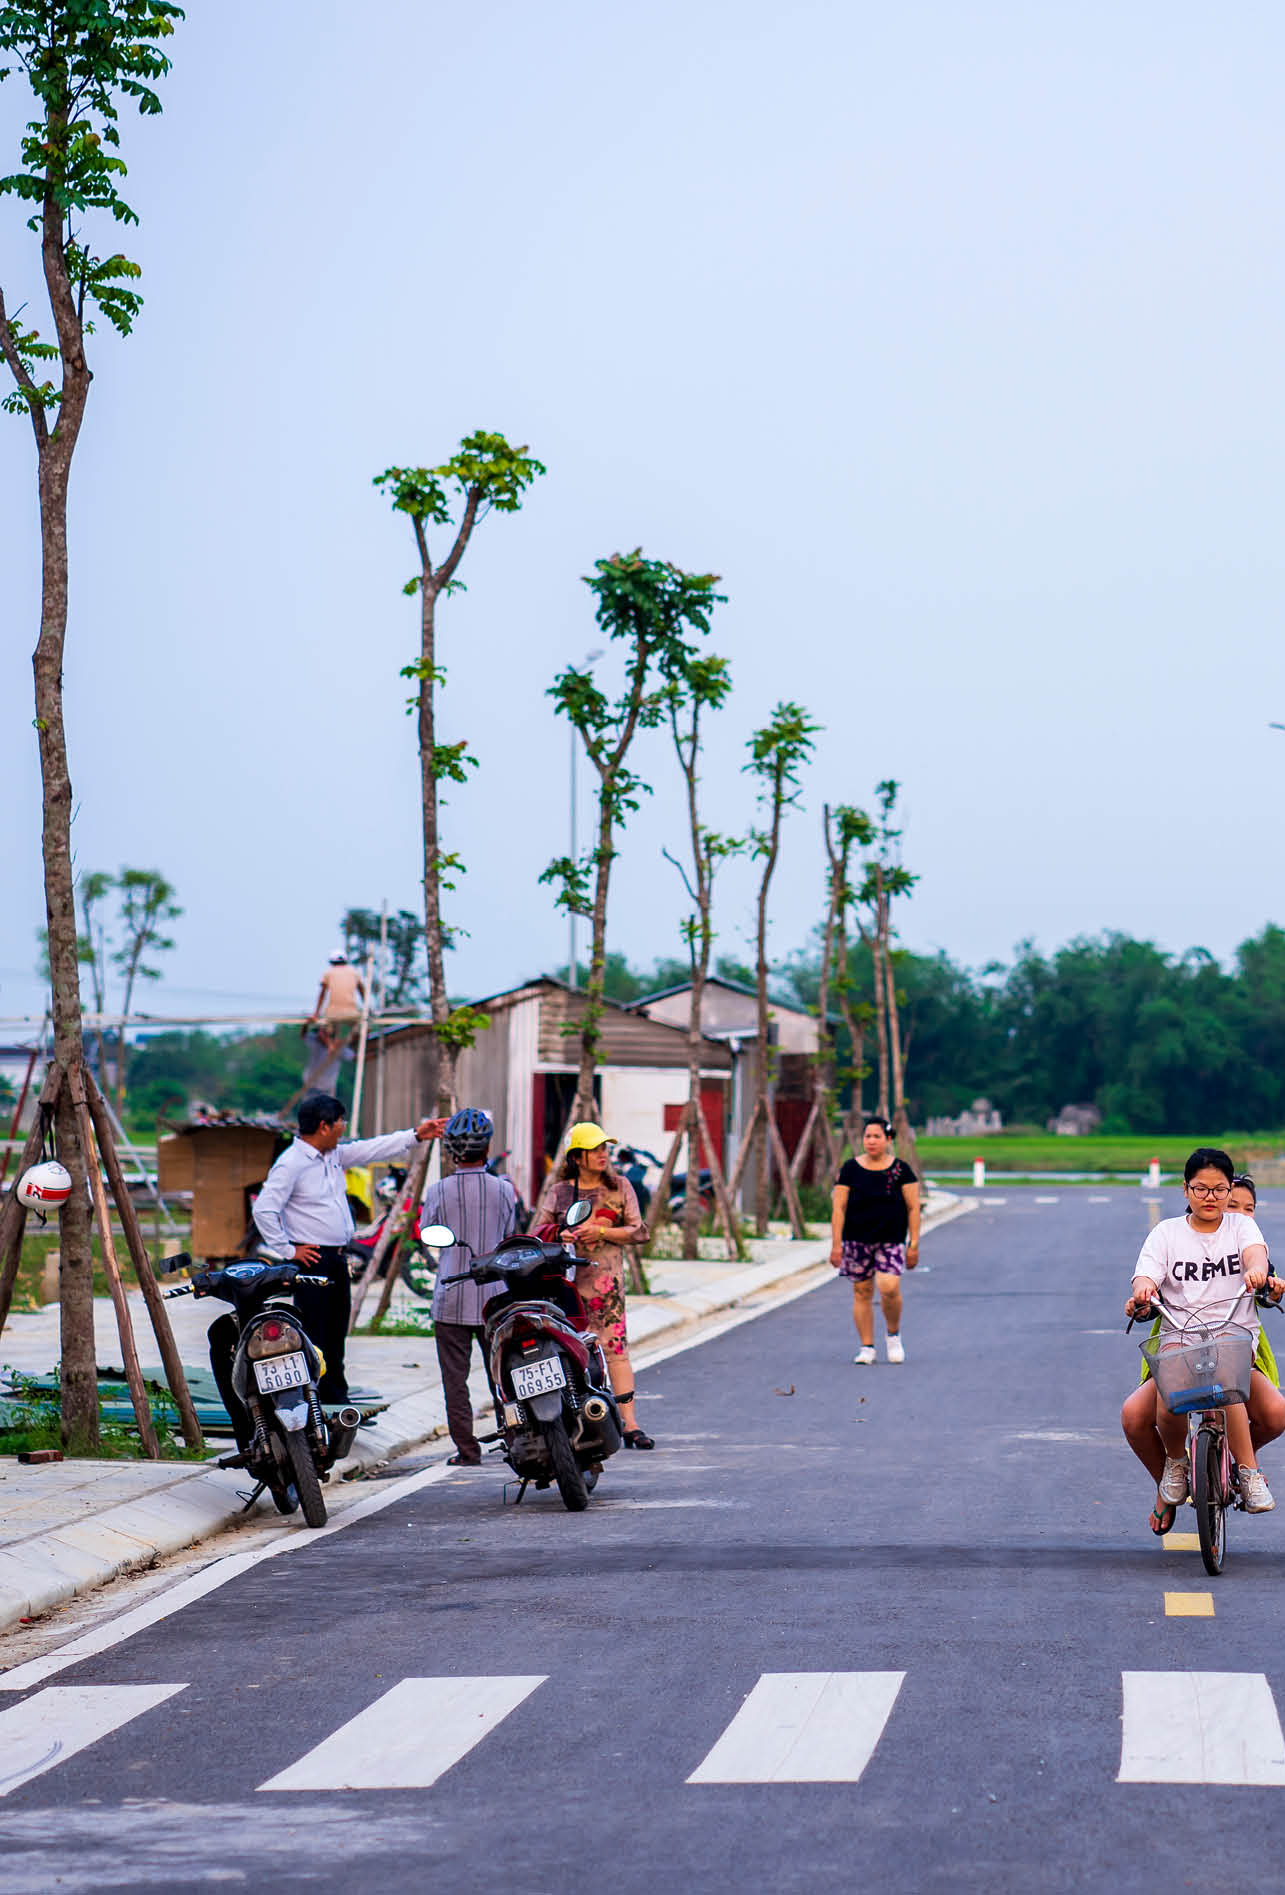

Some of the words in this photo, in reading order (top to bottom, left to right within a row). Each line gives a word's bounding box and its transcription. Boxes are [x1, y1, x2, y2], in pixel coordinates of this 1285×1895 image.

[1172, 1254, 1241, 1281] CRÈME
[265, 1370, 302, 1389] 6090
[519, 1361, 554, 1382] 75-F1
[518, 1373, 562, 1397] 069.55
